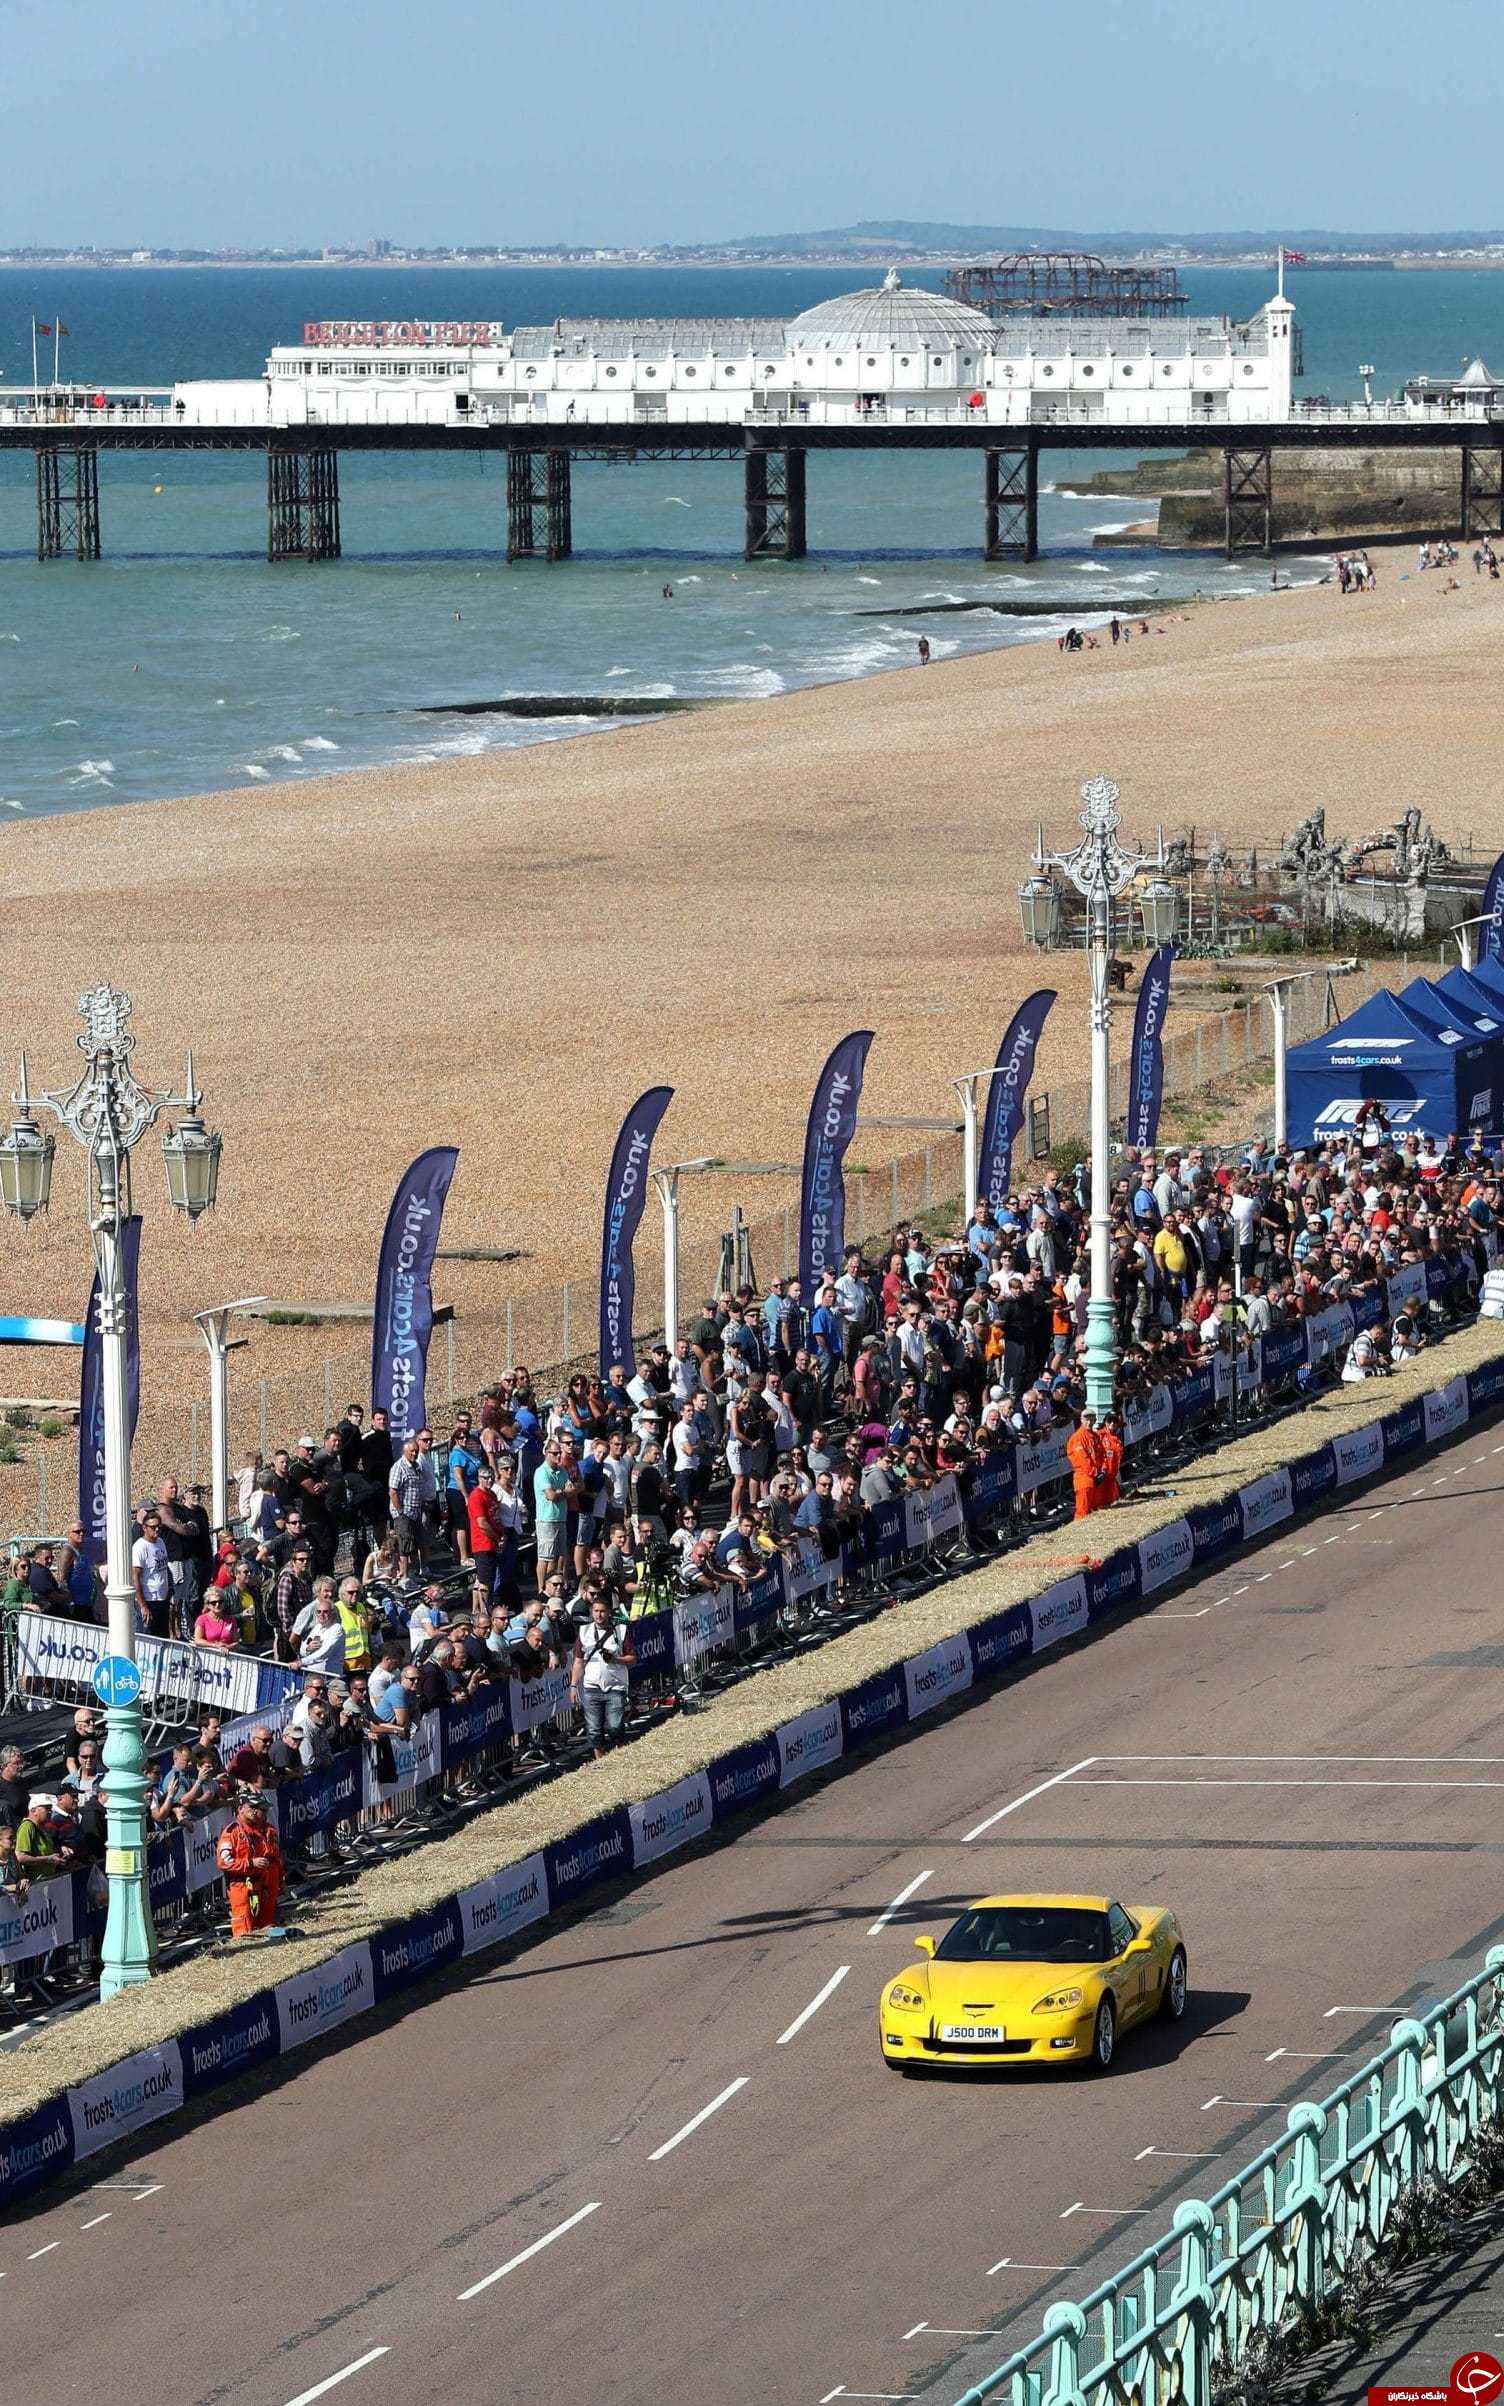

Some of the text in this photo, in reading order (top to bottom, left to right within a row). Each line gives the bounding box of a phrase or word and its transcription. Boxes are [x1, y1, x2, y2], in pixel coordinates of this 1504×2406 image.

[1331, 1055, 1402, 1067] frosts4cars.co.uk
[521, 1670, 572, 1712] frosts4cars.co
[642, 1790, 705, 1843] frosts4cars.co.uk
[555, 1829, 625, 1887] frosts4cars.co.uk
[471, 1876, 540, 1931] frosts4cars.co.uk
[382, 1917, 457, 1977] frosts4cars.co.uk
[288, 1959, 365, 2025] frosts4cars.co.uk
[192, 2011, 272, 2075] frosts4cars.co.uk
[947, 2027, 999, 2038] J500 DRM
[84, 2062, 174, 2131] frosts4cars.co.uk
